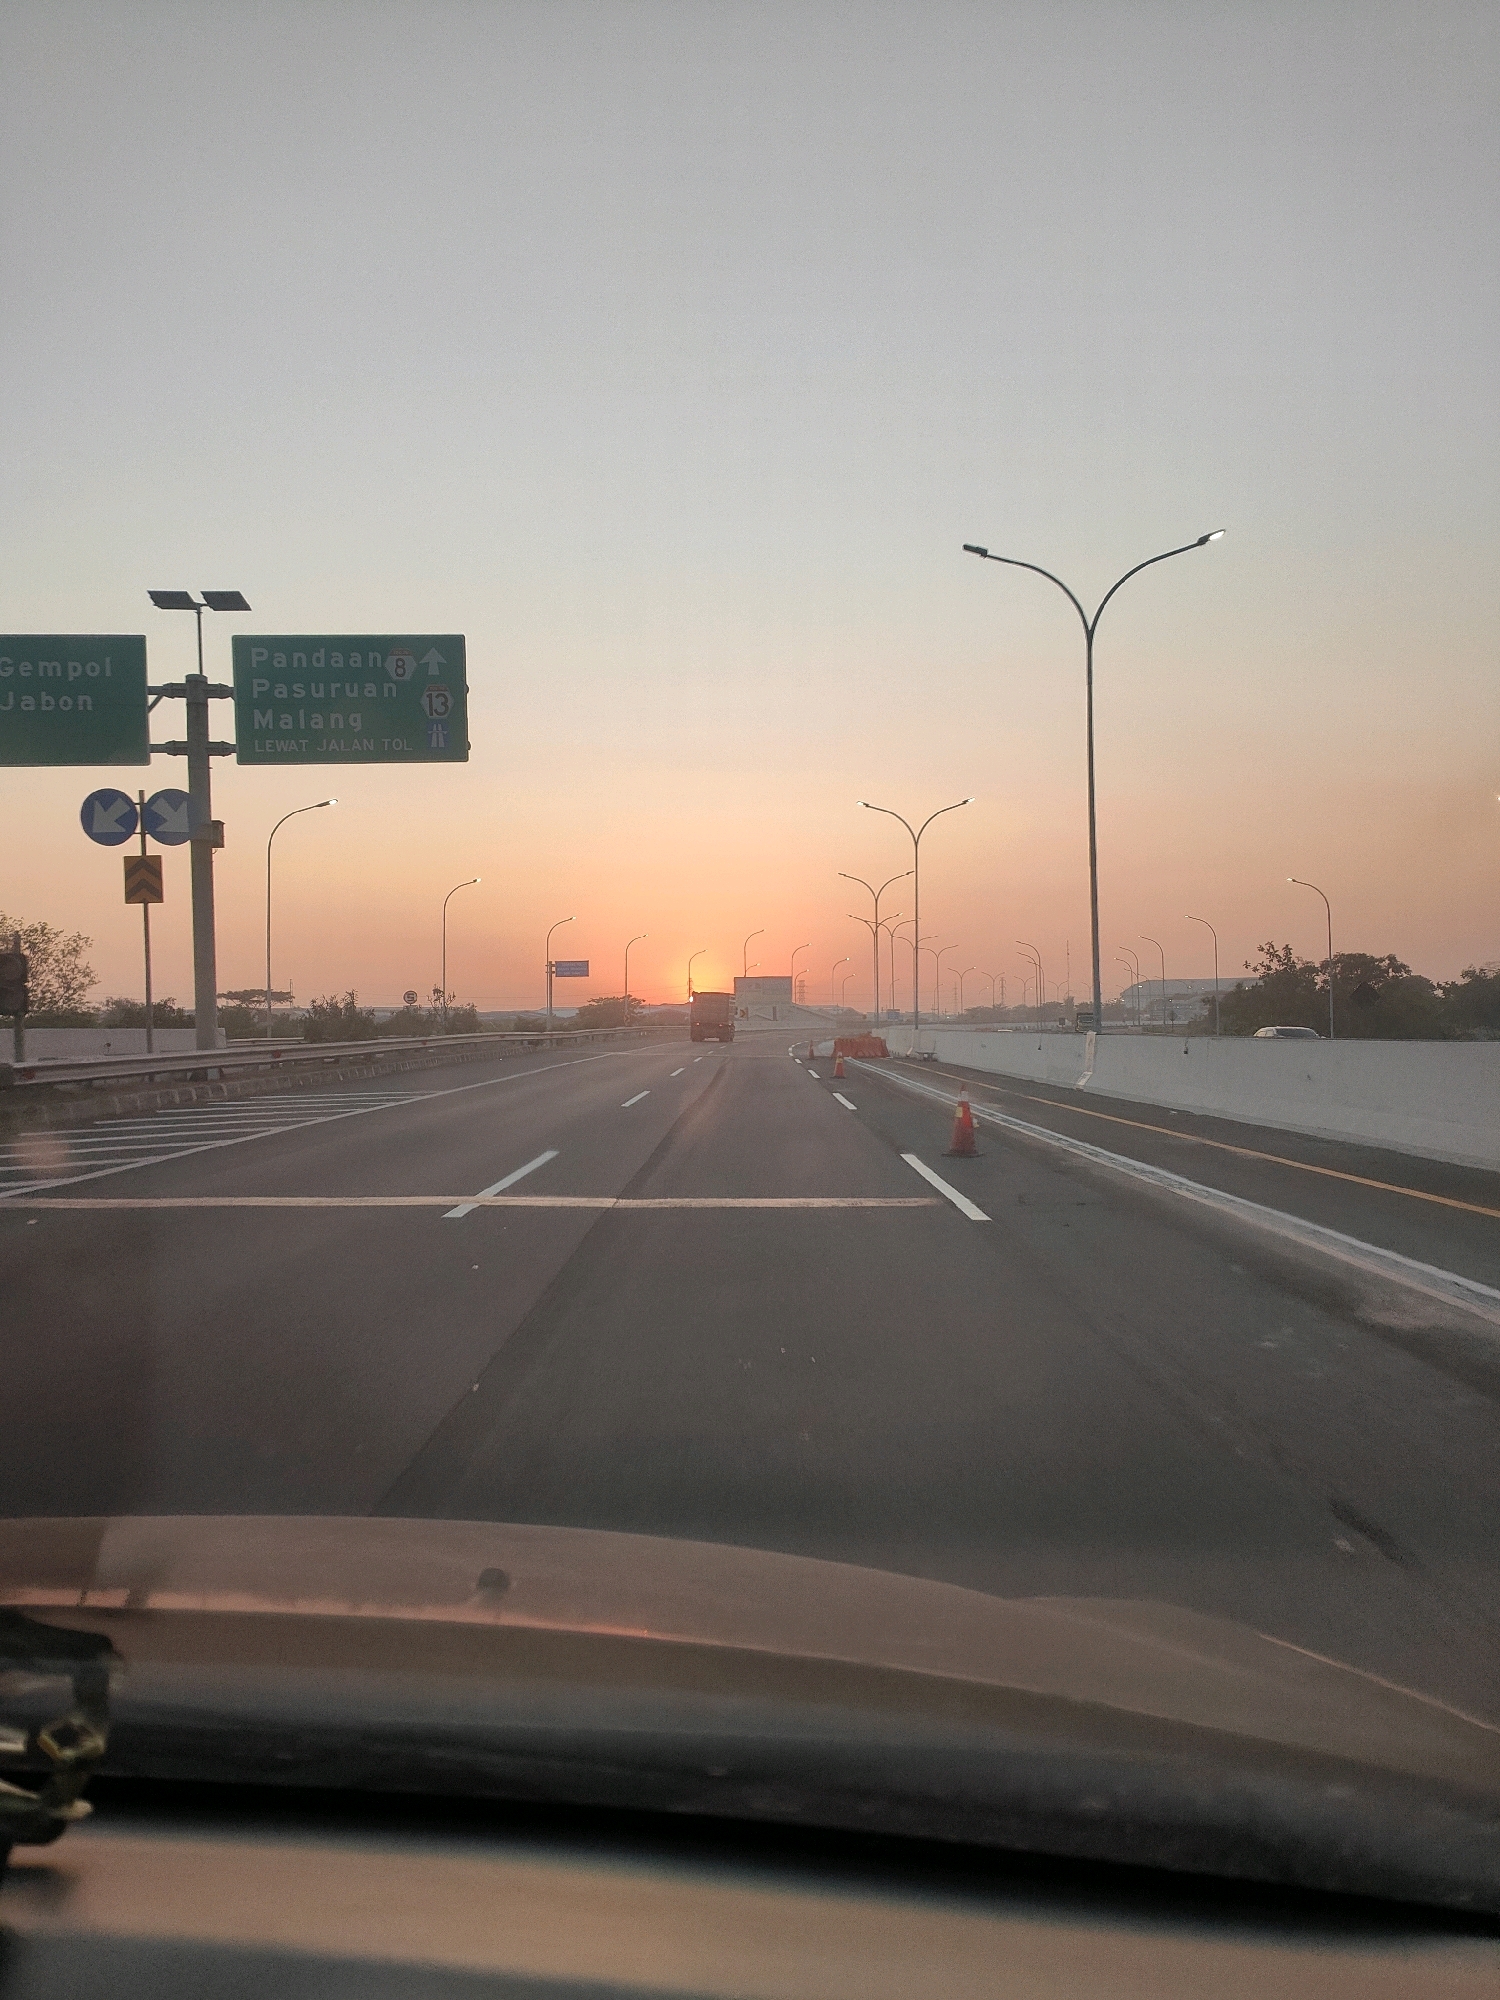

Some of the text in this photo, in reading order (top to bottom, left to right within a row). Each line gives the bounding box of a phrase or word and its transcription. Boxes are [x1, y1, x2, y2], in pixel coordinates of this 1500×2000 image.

[250, 647, 382, 668] Pandaan
[394, 657, 407, 678] 8
[0, 656, 112, 682] Gempol
[252, 678, 397, 699] Pasuruan
[0, 691, 93, 711] Jabon
[426, 692, 450, 717] 13
[253, 708, 362, 732] Malang
[254, 737, 413, 752] LEWAT JALAN TOL
